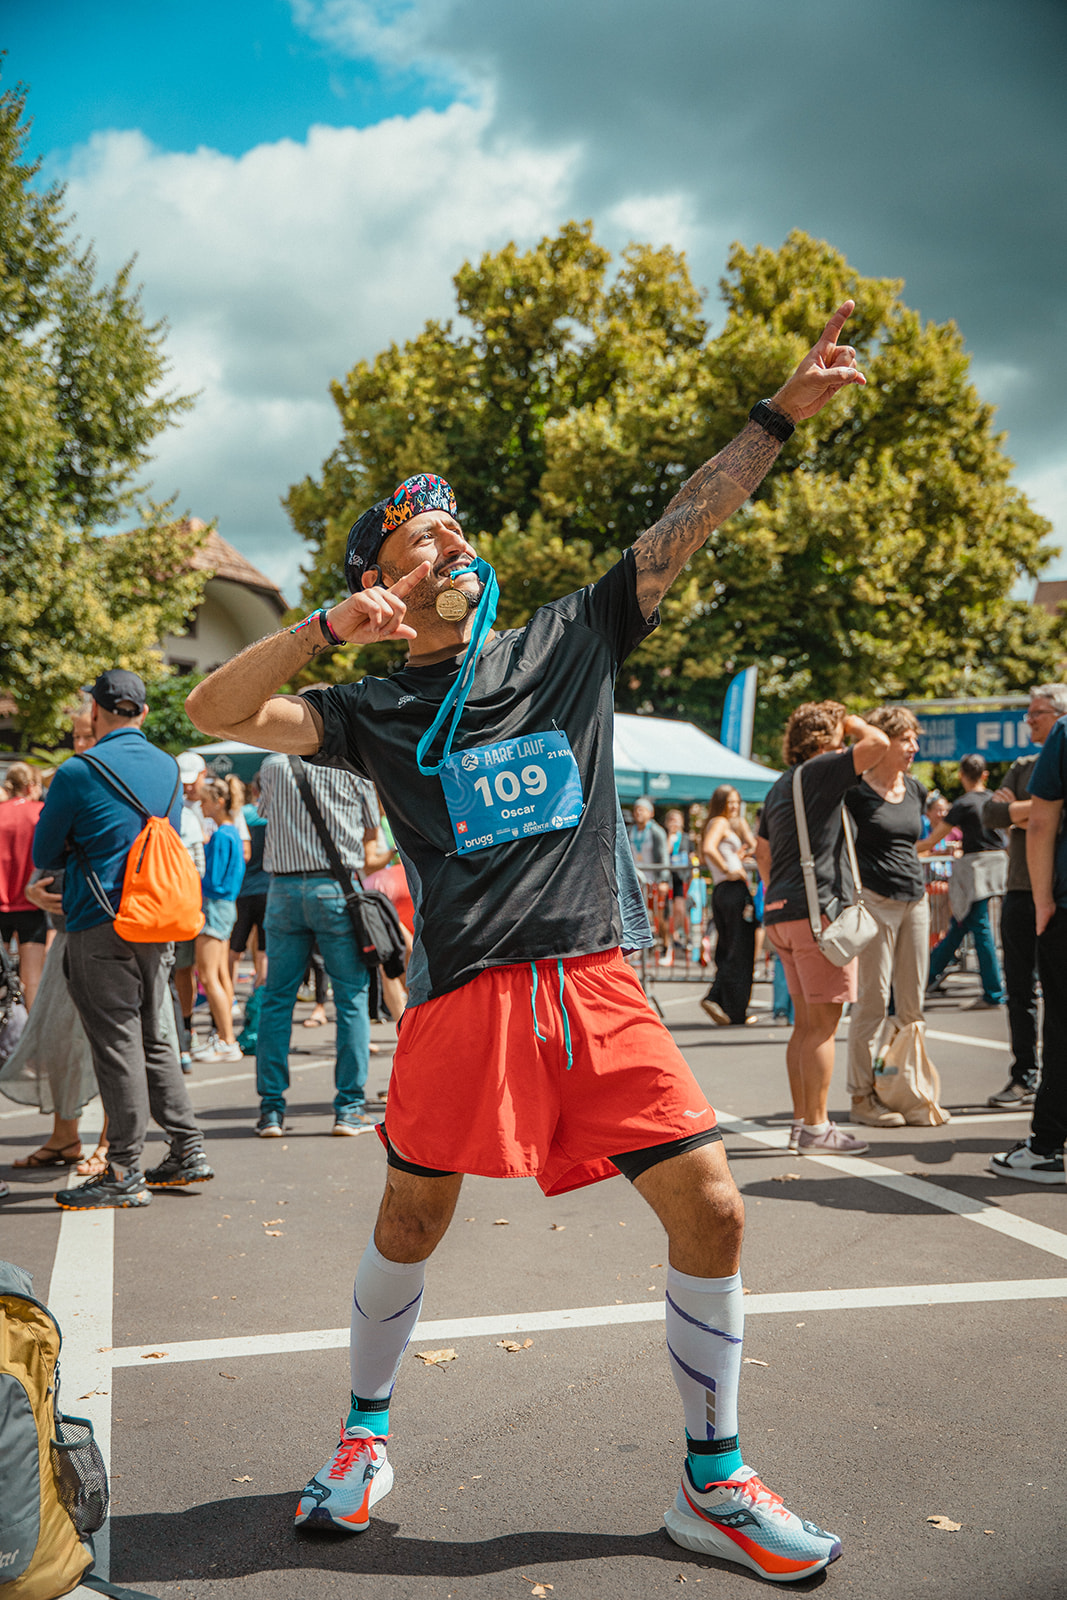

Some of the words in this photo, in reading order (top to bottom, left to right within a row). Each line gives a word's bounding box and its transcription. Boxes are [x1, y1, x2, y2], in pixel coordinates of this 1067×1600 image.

[484, 745, 515, 766] AARE
[516, 739, 545, 758] LAUF
[547, 751, 558, 759] 21
[559, 749, 572, 757] KM
[474, 764, 548, 807] 109
[501, 805, 535, 819] Oscar
[465, 834, 493, 848] brugg
